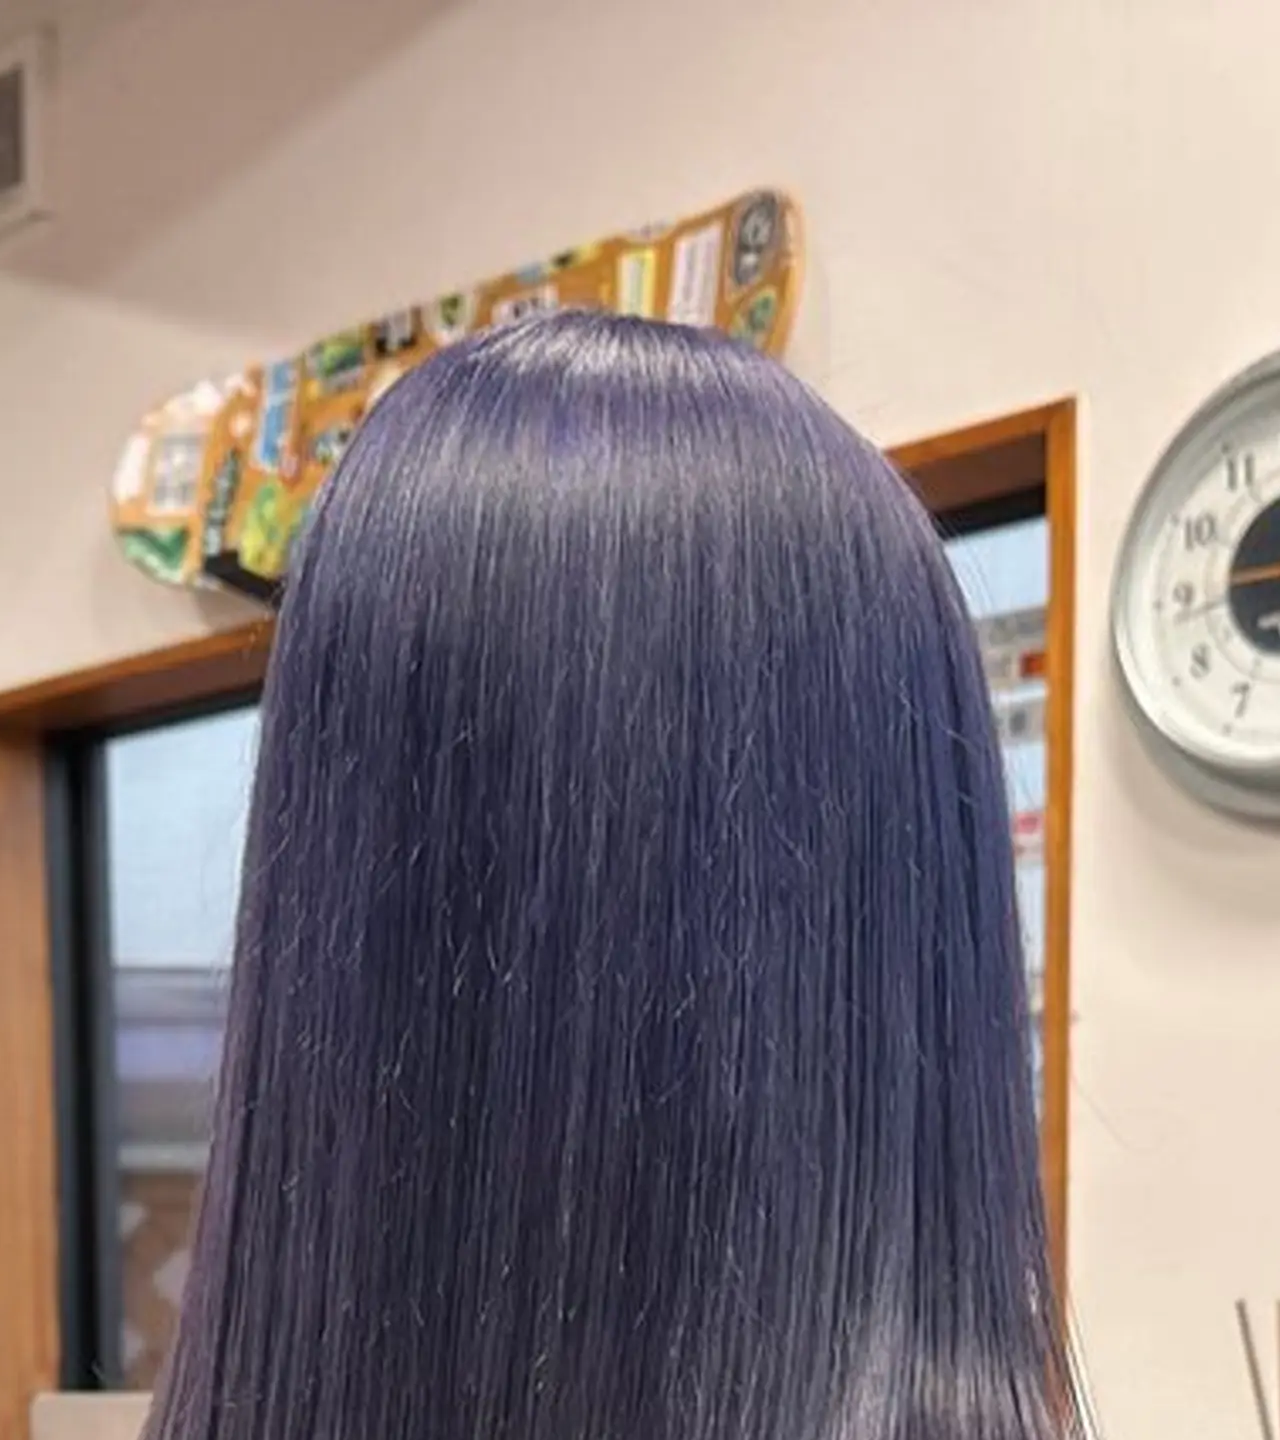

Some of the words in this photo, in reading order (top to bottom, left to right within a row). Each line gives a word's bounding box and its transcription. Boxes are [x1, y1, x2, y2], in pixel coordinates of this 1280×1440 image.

[1227, 454, 1256, 490] 11
[1184, 515, 1215, 552] 10
[1190, 646, 1211, 679] 8
[1231, 682, 1250, 719] 7
